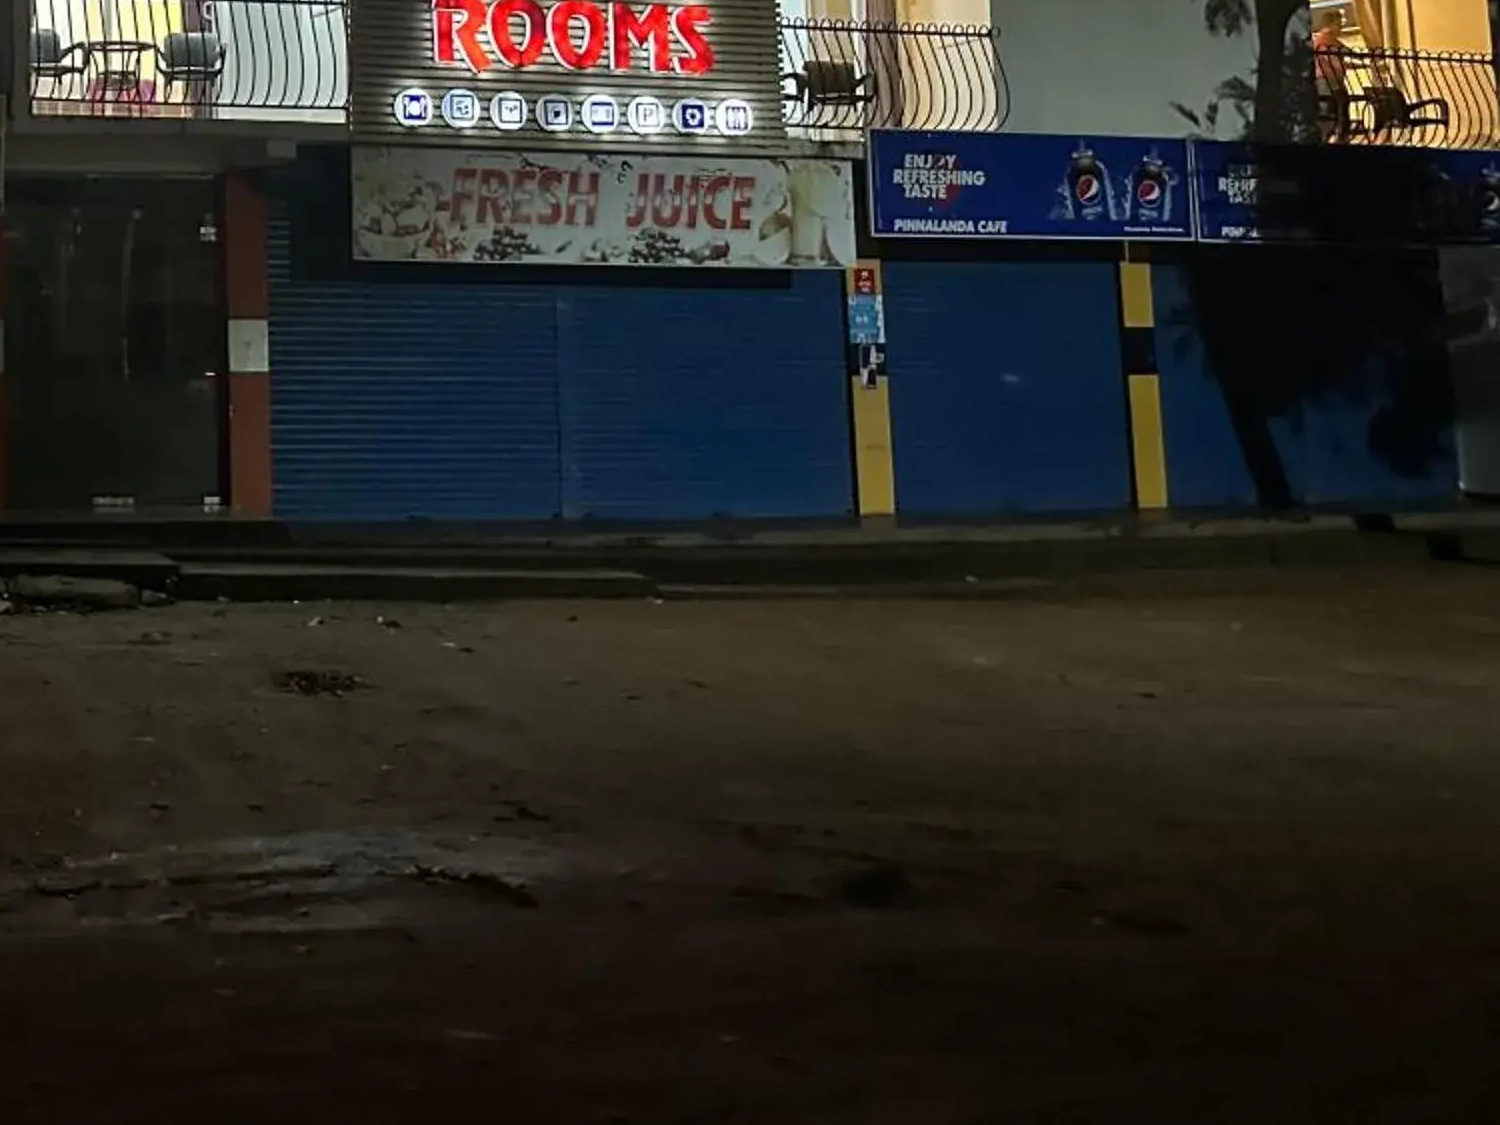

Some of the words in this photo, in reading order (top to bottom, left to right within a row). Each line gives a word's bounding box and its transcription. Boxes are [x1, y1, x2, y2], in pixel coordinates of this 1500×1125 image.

[893, 168, 986, 186] REFRESHING
[449, 168, 598, 227] FRESH
[626, 173, 756, 231] JUICE
[902, 184, 947, 199] TASTE
[893, 218, 975, 233] PINNALANDA
[977, 220, 1007, 234] CAFE
